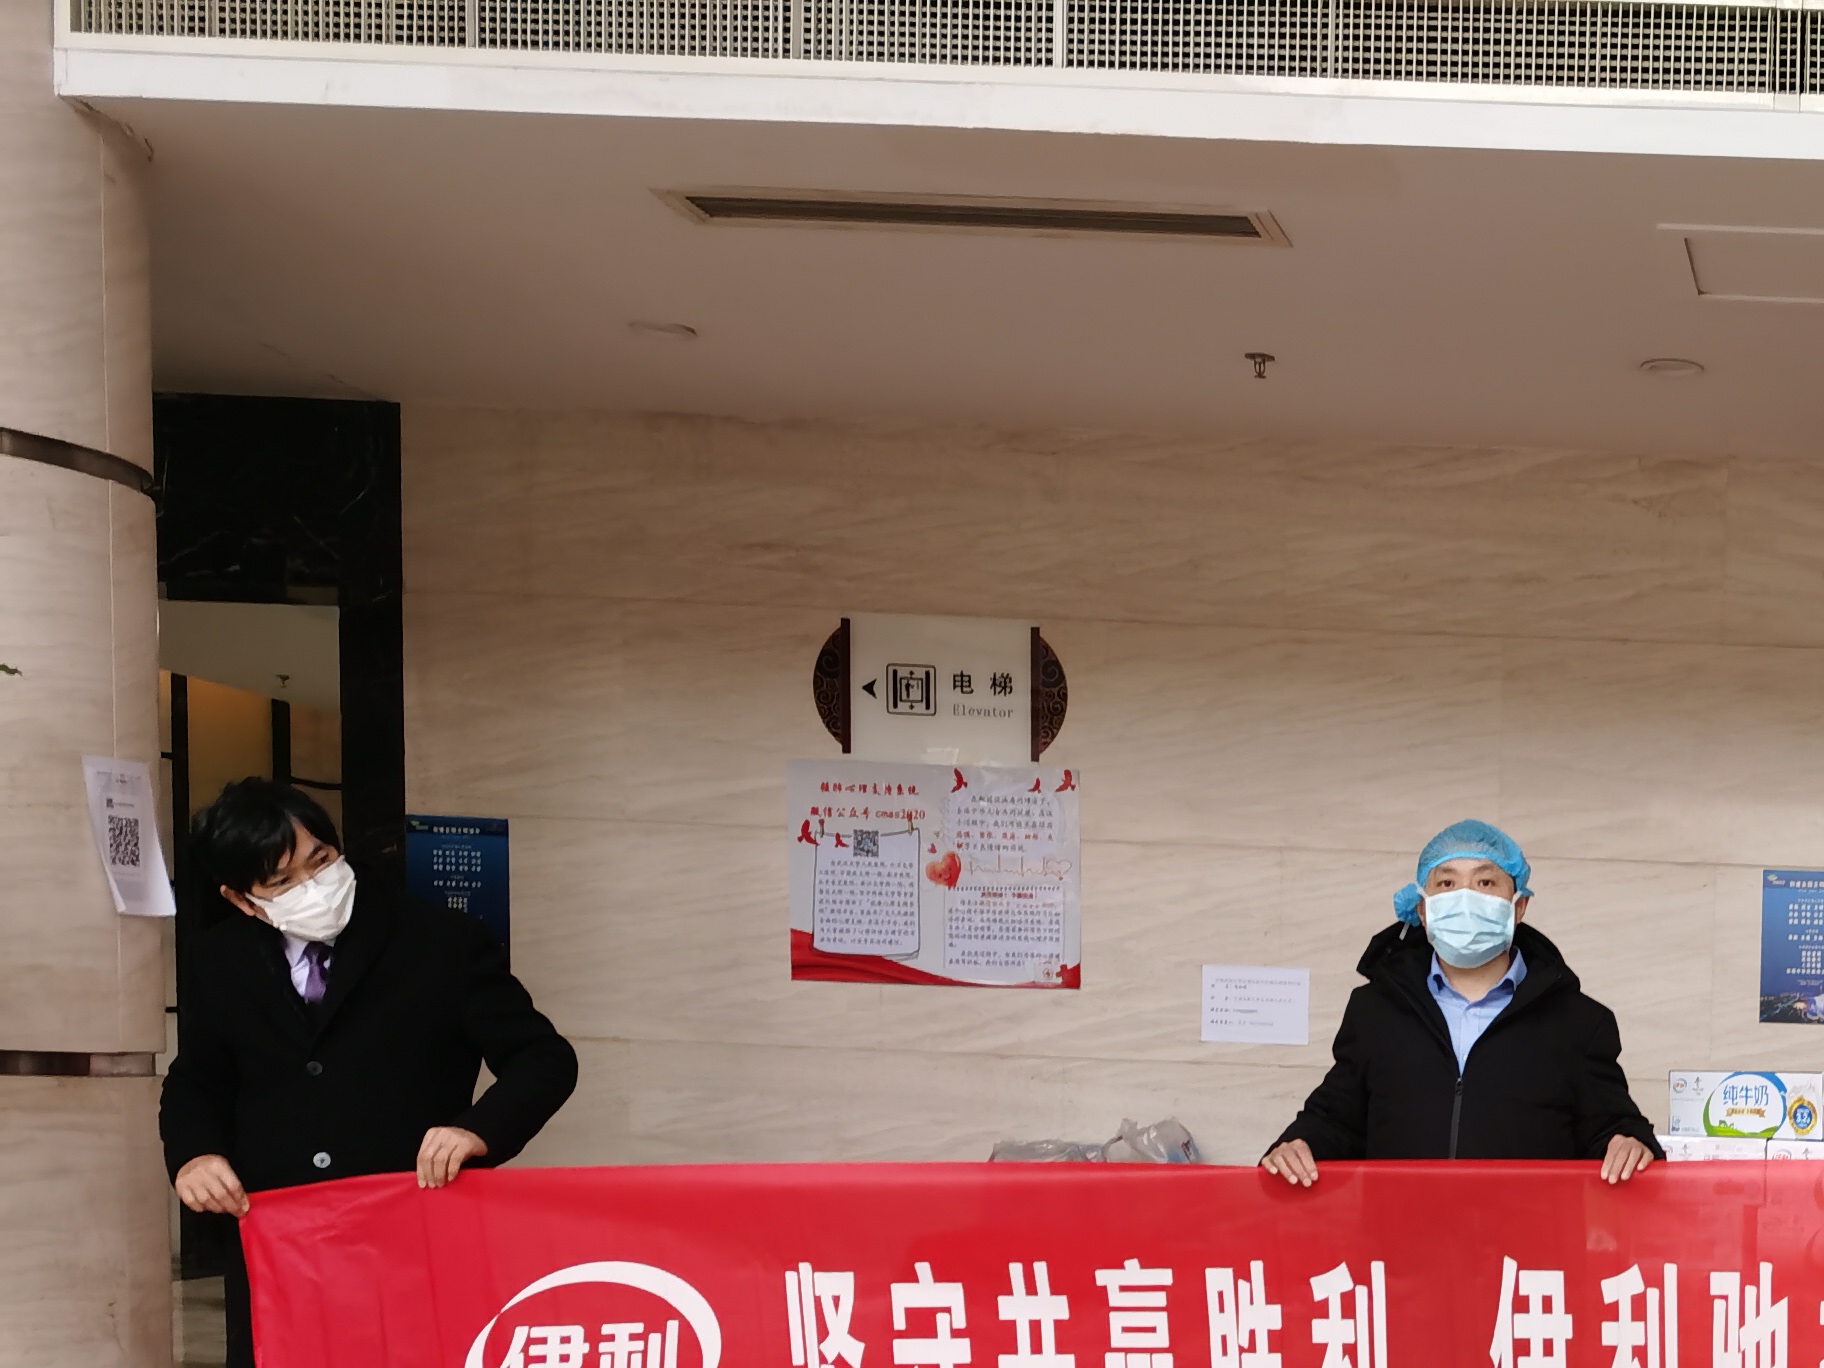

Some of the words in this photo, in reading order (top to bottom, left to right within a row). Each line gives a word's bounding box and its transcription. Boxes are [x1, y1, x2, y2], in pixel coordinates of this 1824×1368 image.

[952, 670, 1014, 698] 电梯
[952, 703, 1014, 719] Elevator
[1722, 1083, 1769, 1107] 纯牛奶
